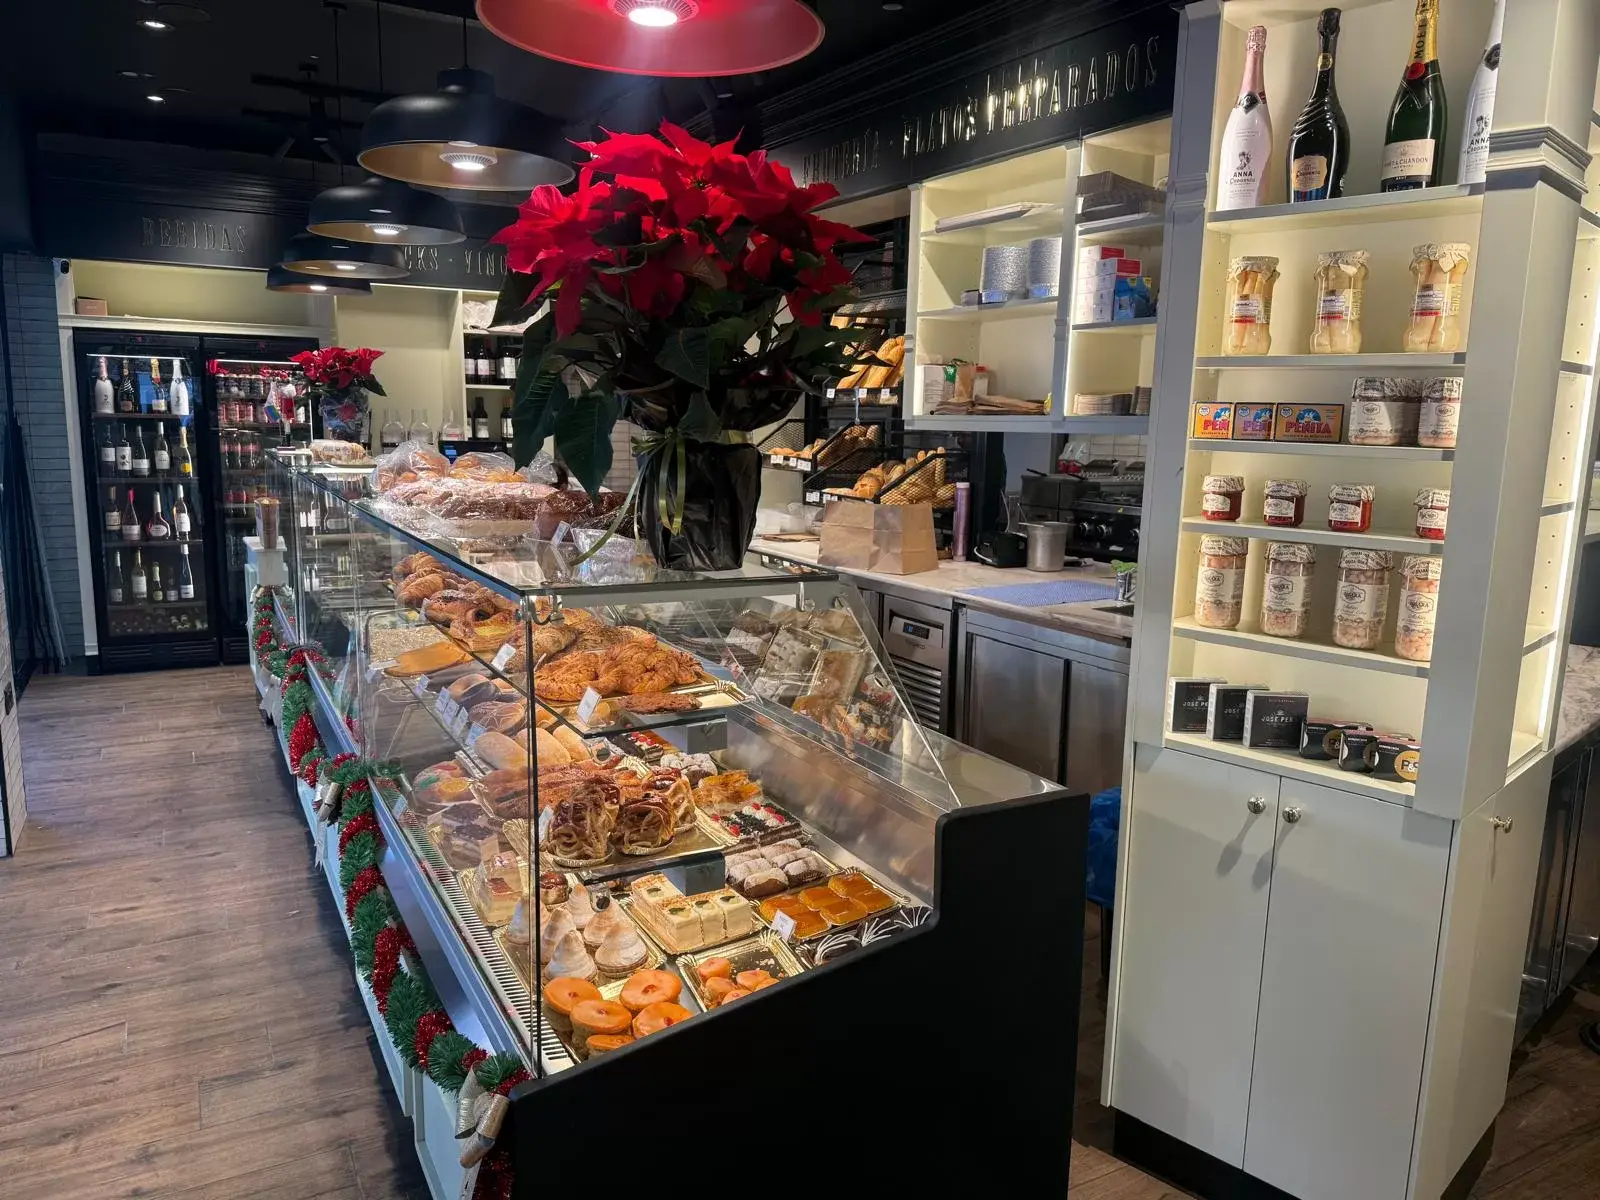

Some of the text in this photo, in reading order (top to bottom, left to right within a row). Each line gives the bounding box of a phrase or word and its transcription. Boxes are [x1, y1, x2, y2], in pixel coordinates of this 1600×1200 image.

[902, 96, 978, 159] PLATOS
[986, 35, 1160, 136] PREPARADOS
[141, 215, 249, 254] BEBIDAS
[404, 245, 508, 277] CKS VINO
